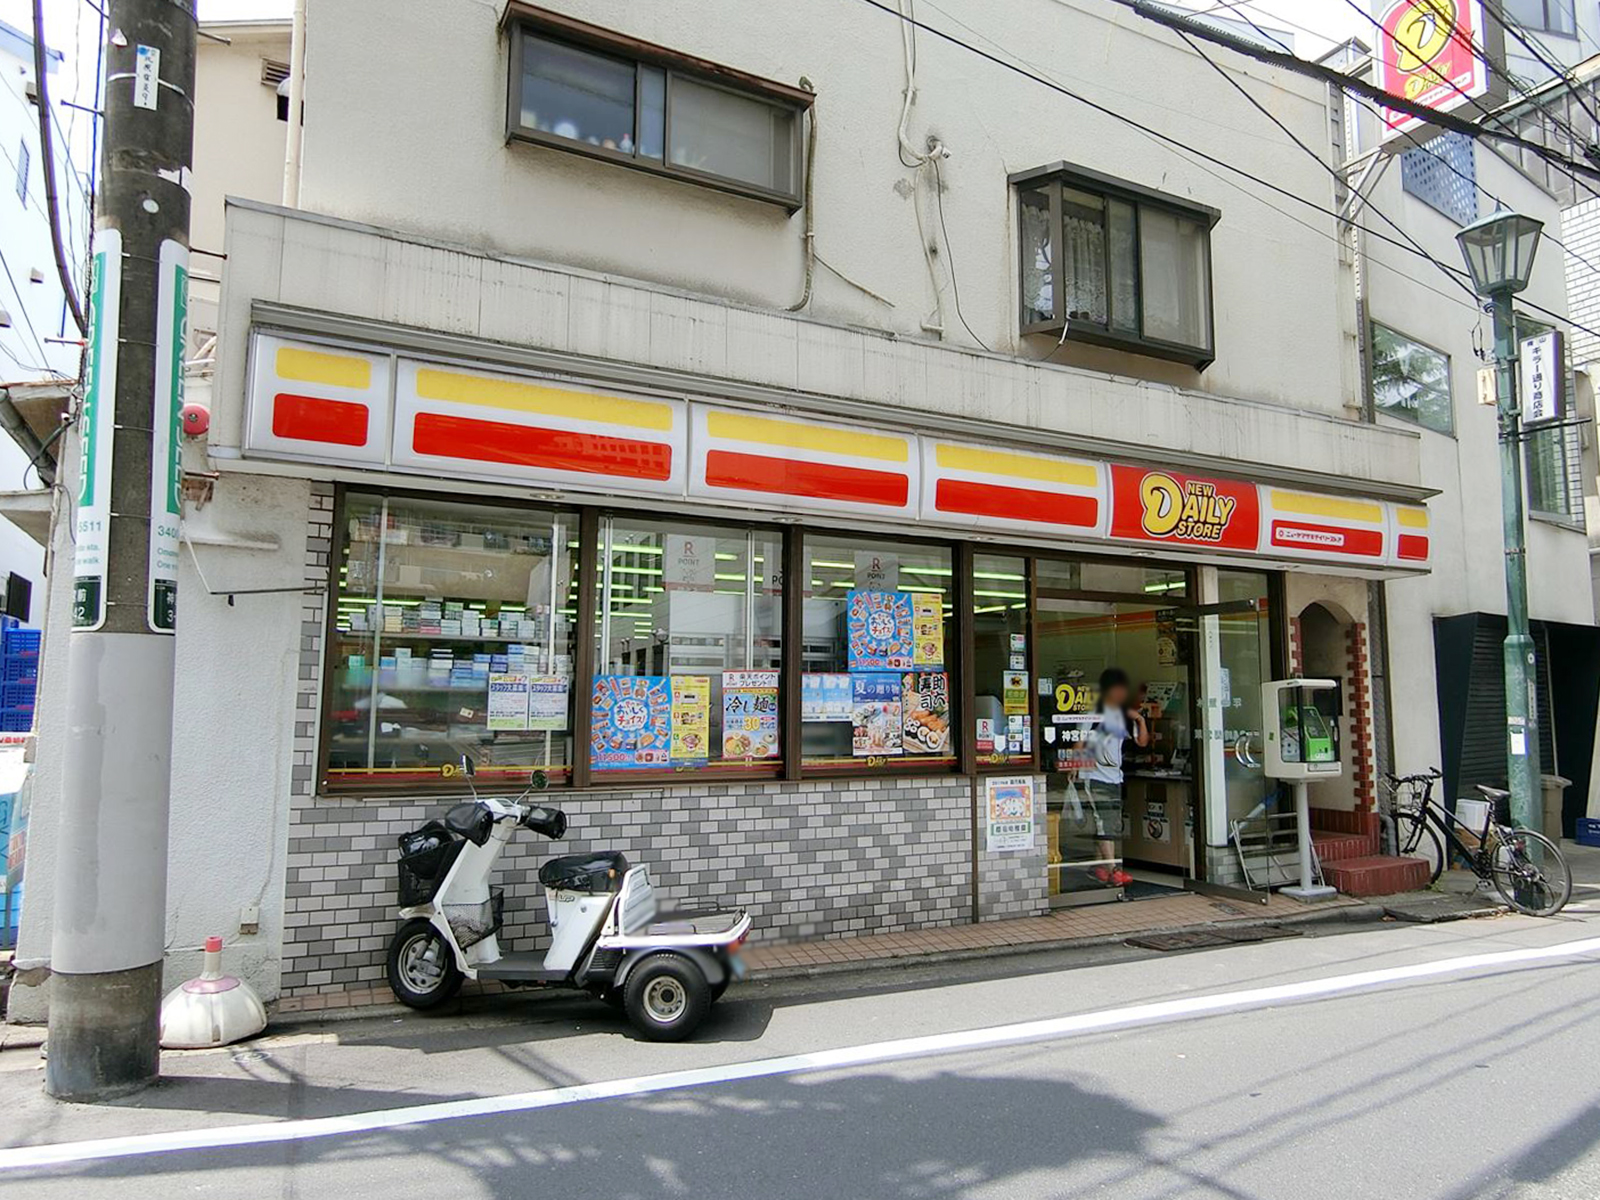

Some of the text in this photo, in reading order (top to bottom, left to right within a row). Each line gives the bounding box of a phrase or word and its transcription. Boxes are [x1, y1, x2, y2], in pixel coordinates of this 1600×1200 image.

[1187, 482, 1214, 496] NEW
[1176, 521, 1221, 538] STORE
[684, 541, 694, 555] R
[872, 558, 880, 570] R
[726, 695, 769, 713] 冷し麺
[744, 716, 760, 731] 30
